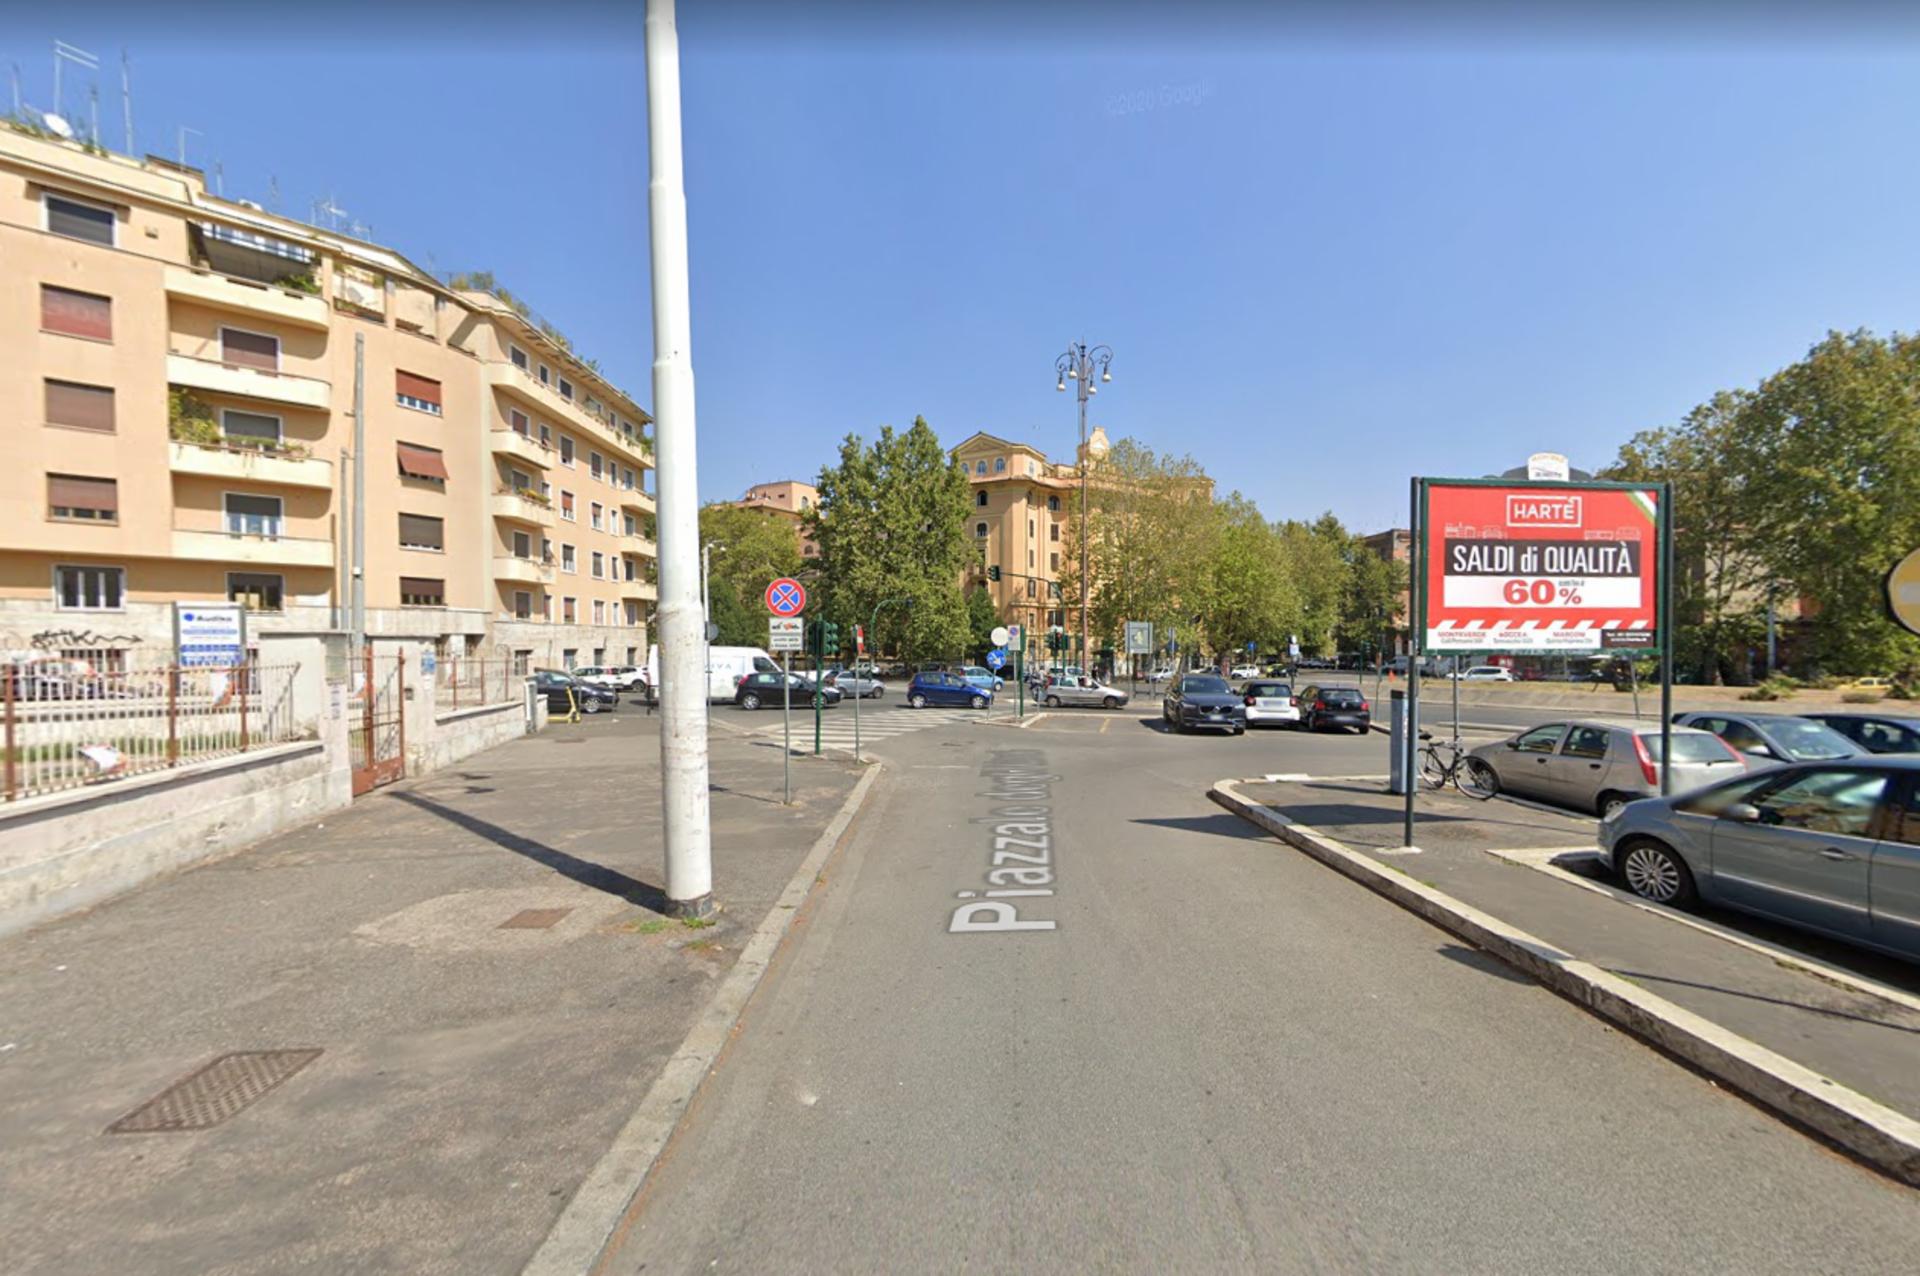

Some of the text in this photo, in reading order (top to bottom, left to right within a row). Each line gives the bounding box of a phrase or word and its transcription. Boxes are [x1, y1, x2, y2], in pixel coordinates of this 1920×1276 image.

[1514, 497, 1575, 519] HARTÉ
[1453, 541, 1632, 573] SALDI di QUALITÀ
